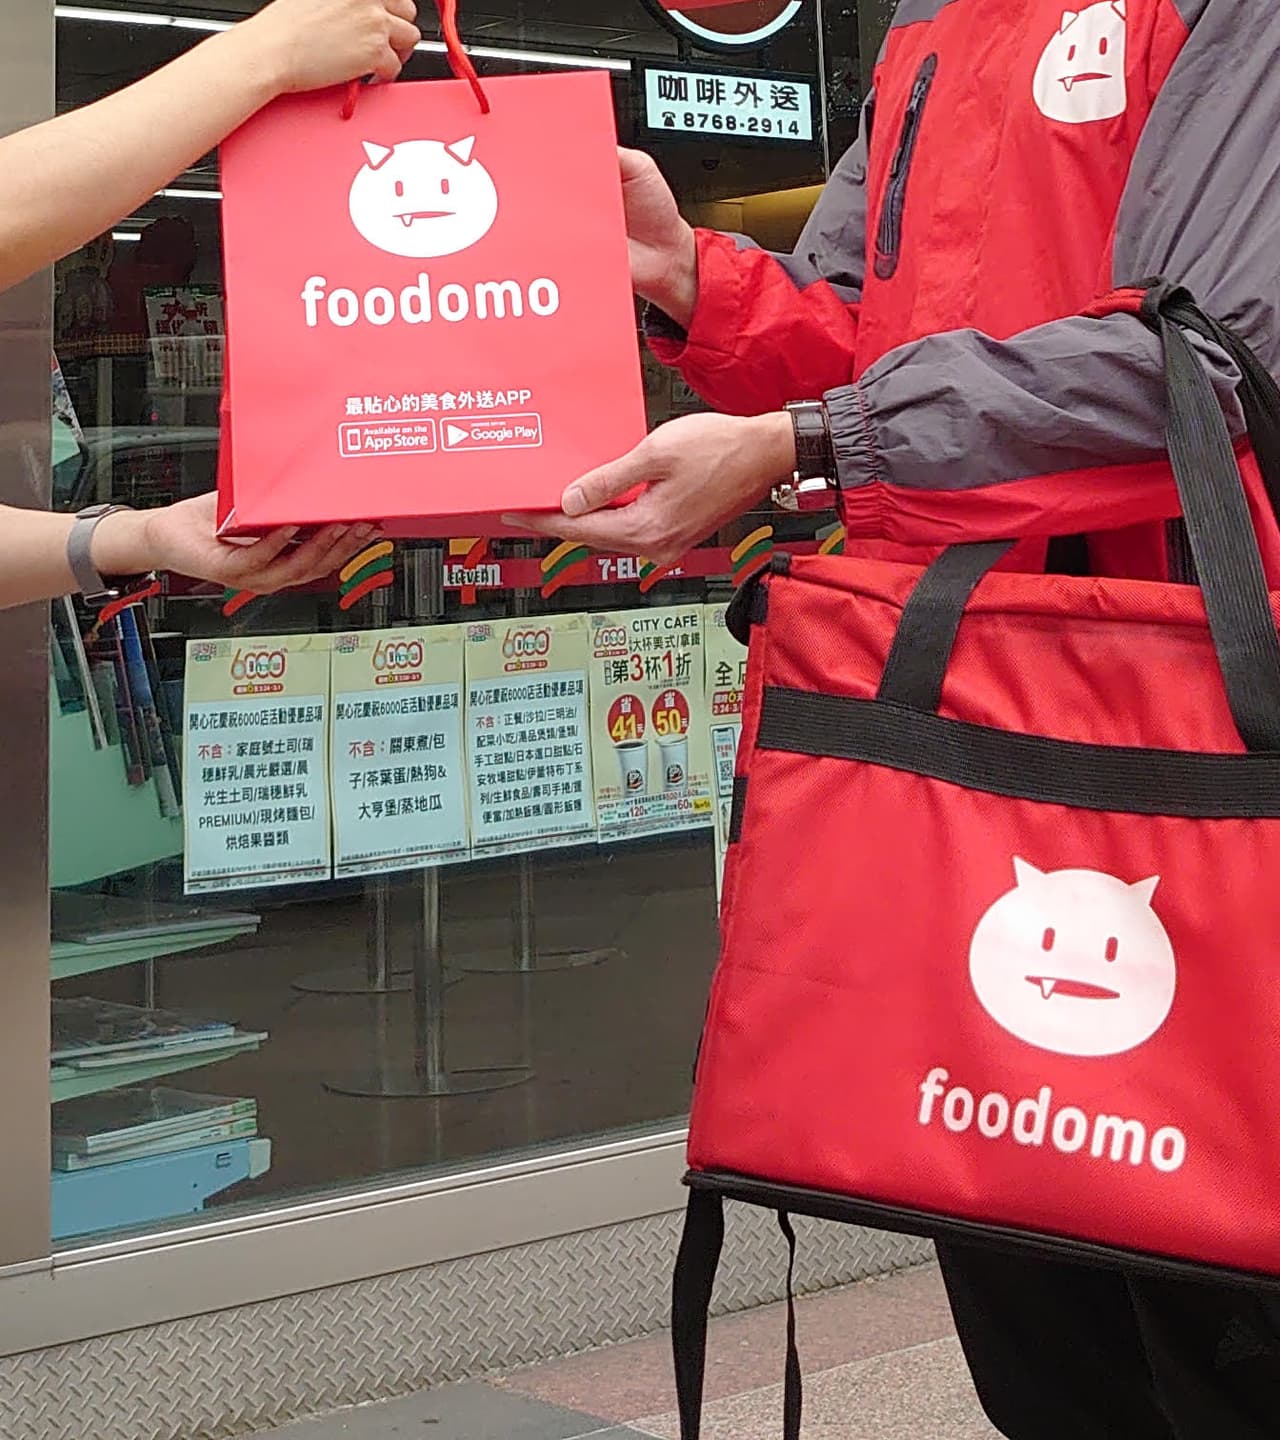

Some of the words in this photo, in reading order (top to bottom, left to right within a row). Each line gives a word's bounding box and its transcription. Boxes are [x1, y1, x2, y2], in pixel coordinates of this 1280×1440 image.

[657, 74, 800, 111] 咖啡外送
[683, 111, 800, 136] 8768-2914
[301, 271, 560, 327] foodomo
[345, 390, 531, 416] 最貼心的美食外送APP
[365, 435, 392, 451] App
[394, 433, 428, 448] Store
[471, 427, 512, 442] Google
[515, 426, 538, 441] Play
[632, 618, 660, 633] CITY
[664, 614, 698, 629] CAFE
[611, 650, 692, 684] 第3杯1折
[620, 697, 633, 713] 省
[664, 691, 676, 708] 省
[226, 830, 289, 851] 烘焙果醬類
[918, 1066, 1186, 1173] foodomo
